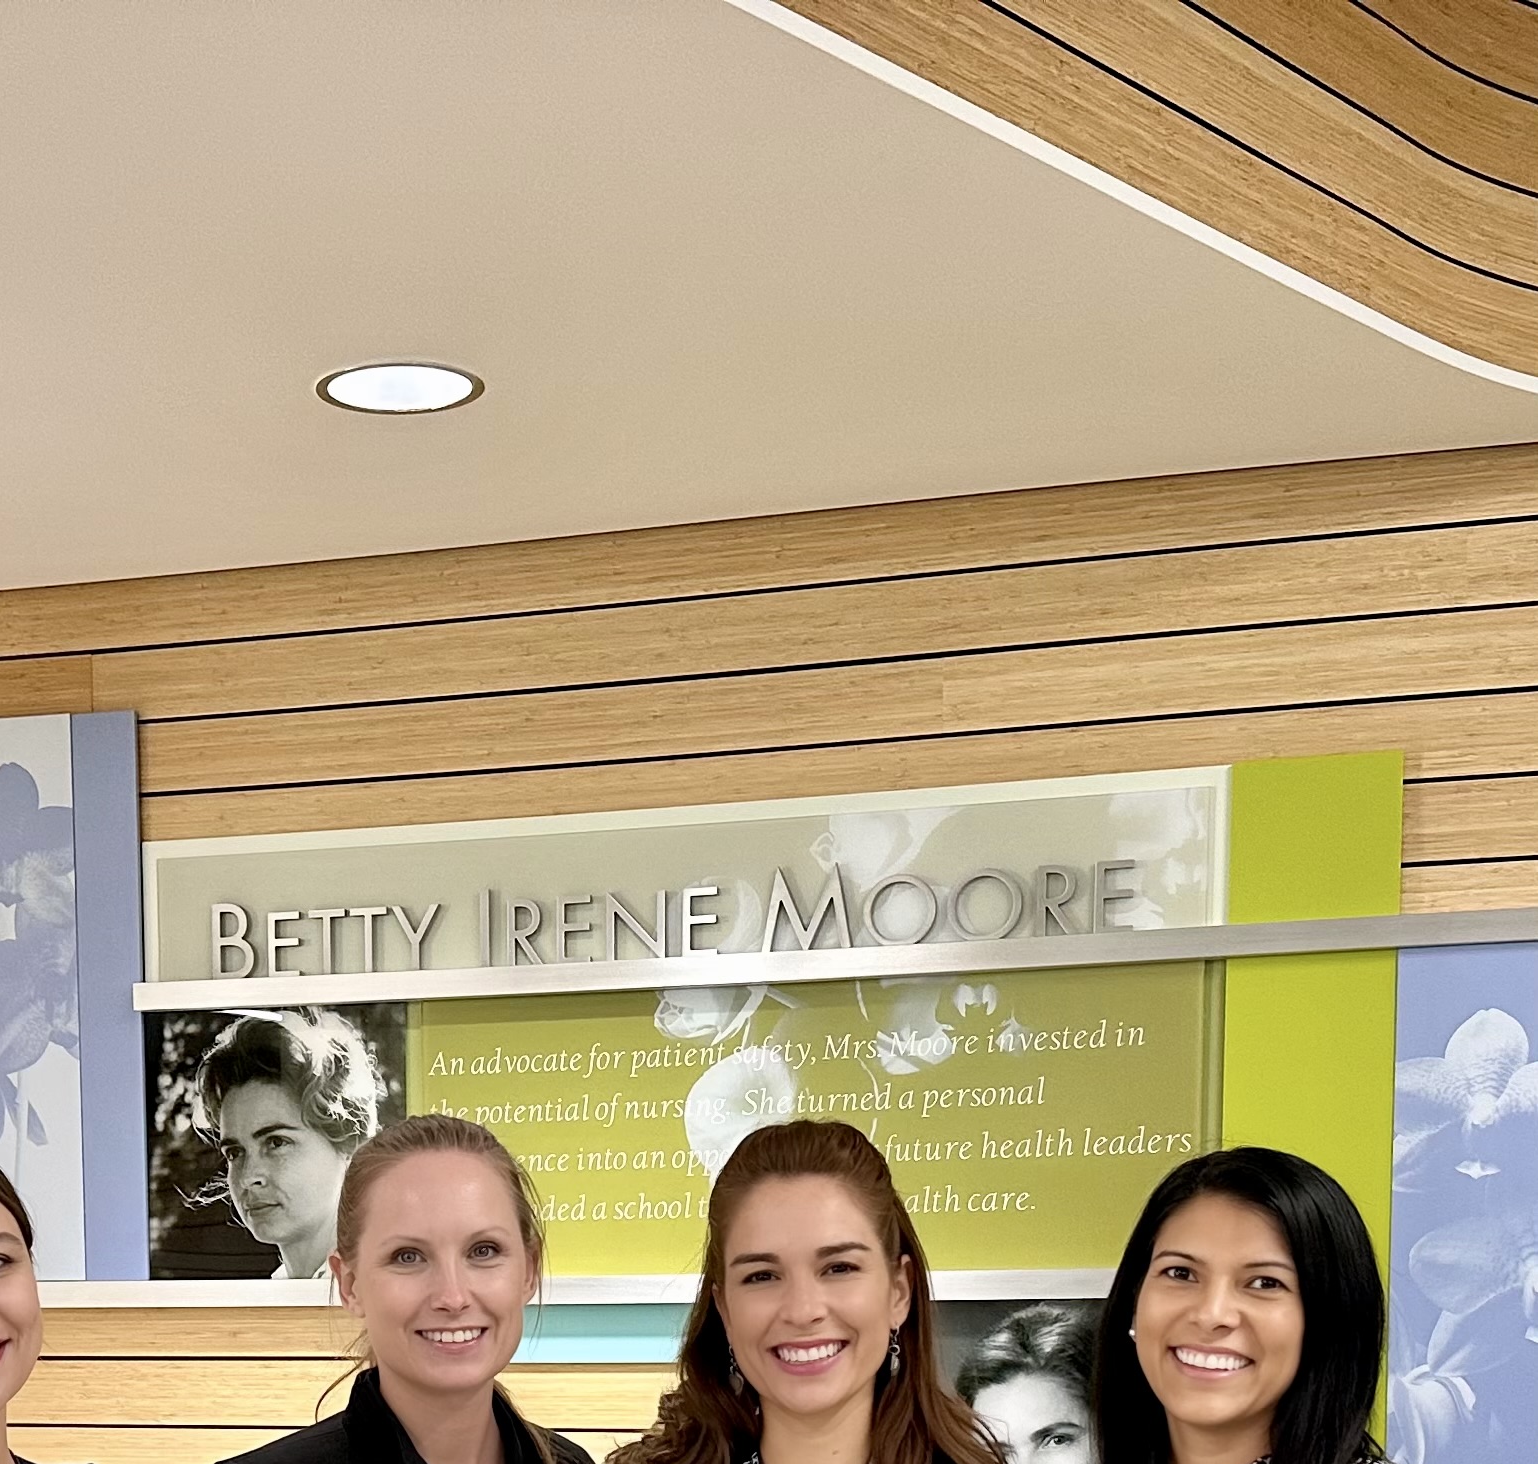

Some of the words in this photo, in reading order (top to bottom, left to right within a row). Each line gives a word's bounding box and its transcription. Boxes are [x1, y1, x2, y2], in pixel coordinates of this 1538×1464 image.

[429, 1052, 464, 1076] An
[471, 1047, 582, 1075] advocate
[583, 1043, 624, 1078] for
[630, 1041, 725, 1078] patient
[732, 1034, 816, 1069] safety,
[823, 1034, 882, 1061] Mrs.
[889, 1030, 978, 1056] Moore
[987, 1020, 1107, 1053] invested
[1116, 1021, 1145, 1048] in
[429, 1099, 468, 1118] the
[476, 1094, 590, 1124] potential
[595, 1093, 620, 1127] of
[625, 1099, 731, 1124] nursing.
[742, 1088, 790, 1115] She
[796, 1083, 892, 1113] turned
[899, 1091, 915, 1109] a
[922, 1077, 1045, 1117] personal
[577, 1147, 628, 1172] into
[633, 1151, 666, 1170] an
[886, 1134, 973, 1162] future
[982, 1128, 1074, 1160] health
[1084, 1126, 1192, 1157] leaders
[592, 1200, 607, 1220] a
[613, 1193, 692, 1220] school
[906, 1185, 960, 1214] alth
[968, 1189, 1036, 1212] care.
